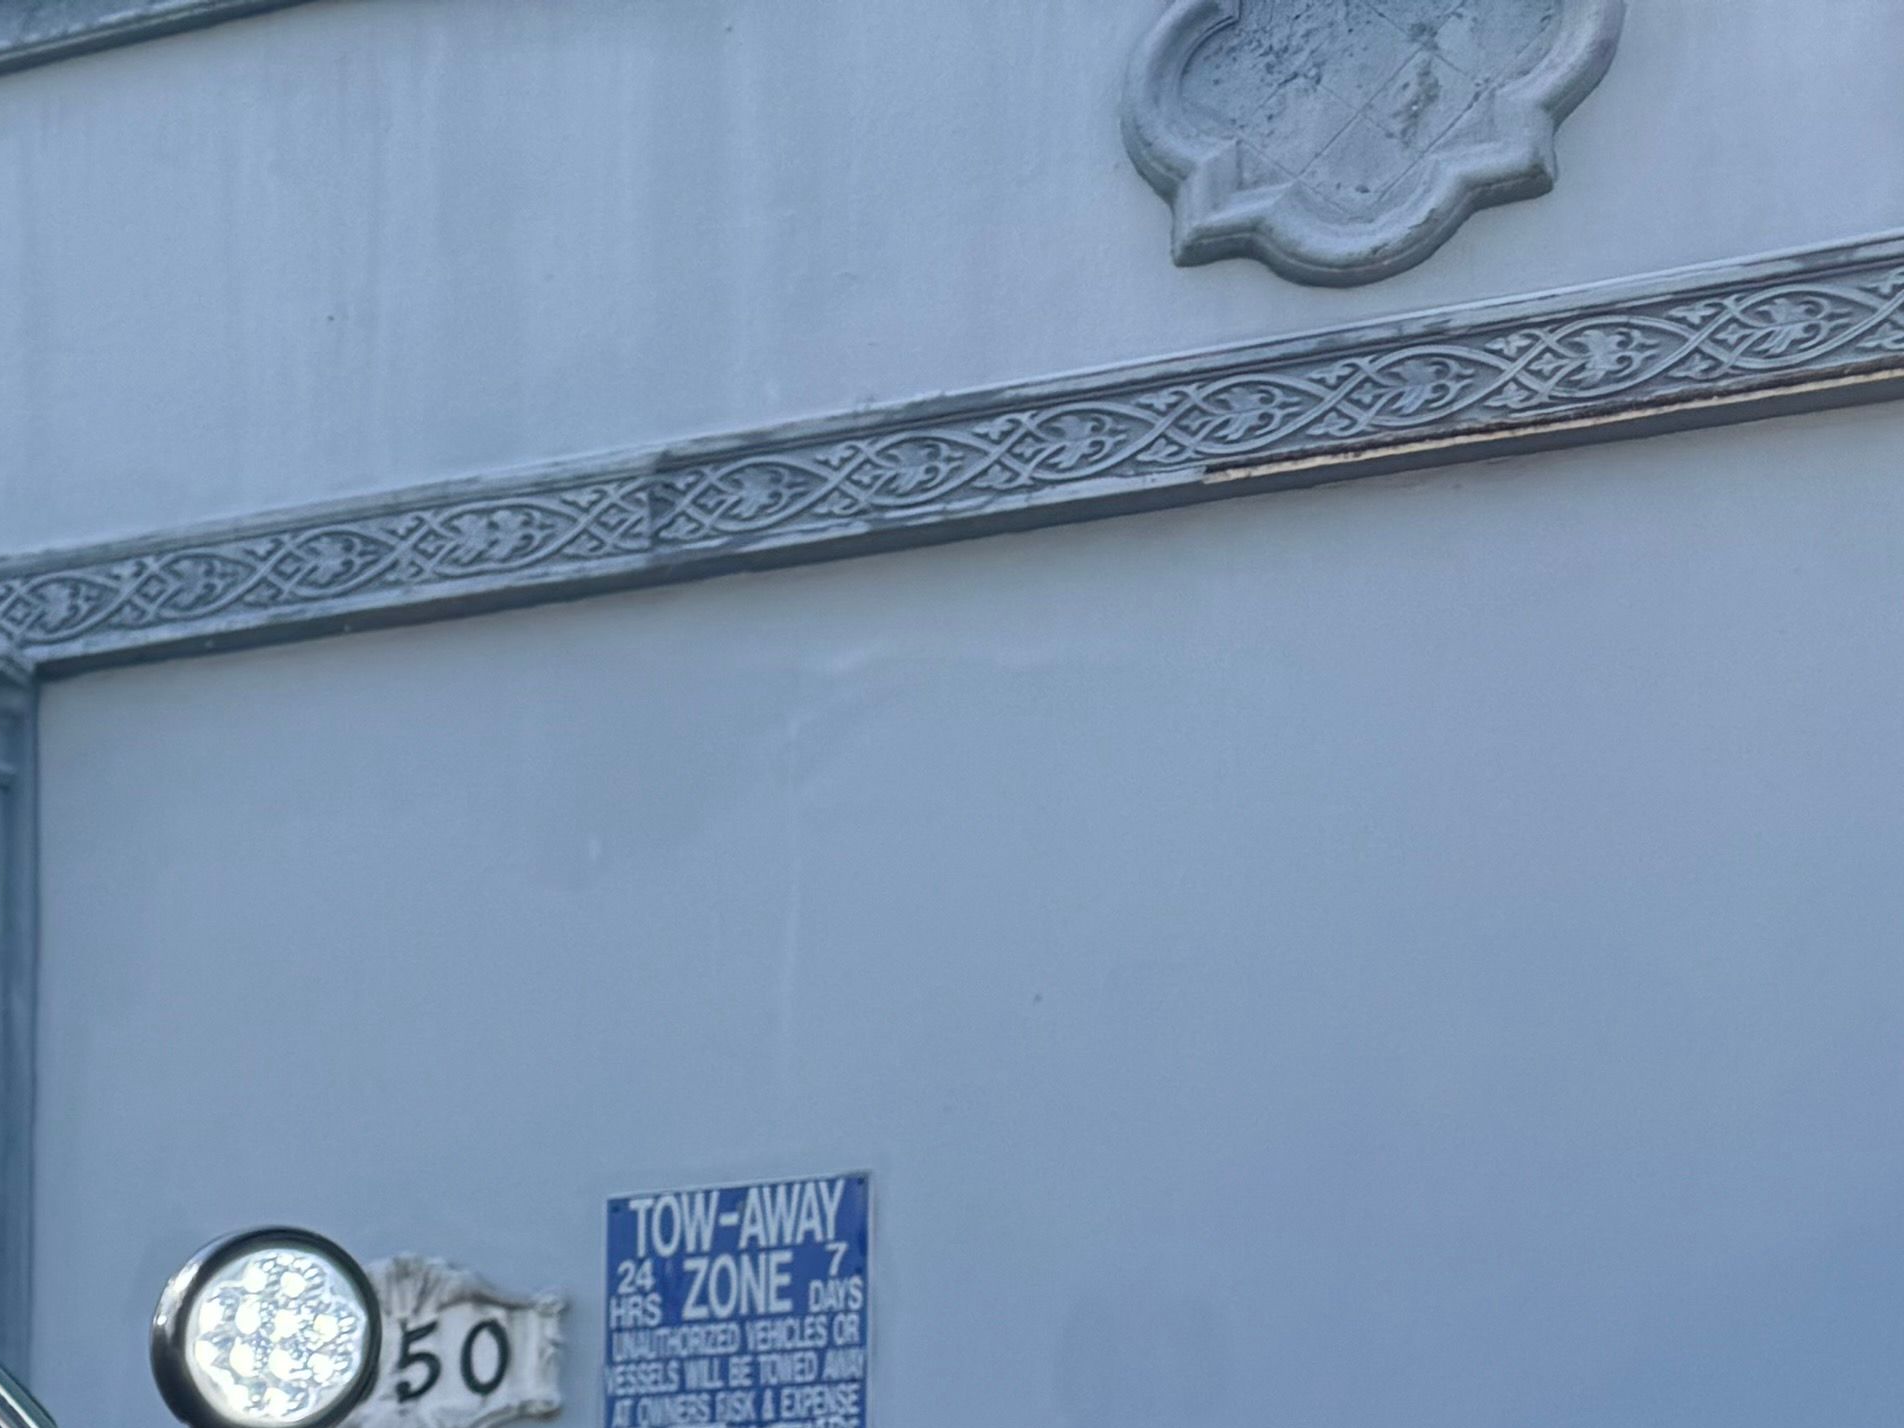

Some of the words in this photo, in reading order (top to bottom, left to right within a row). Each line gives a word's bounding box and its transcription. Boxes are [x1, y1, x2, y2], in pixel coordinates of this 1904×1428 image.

[629, 1179, 846, 1257] TOW-AWAY
[617, 1259, 654, 1294] 24
[826, 1242, 848, 1276] 7
[682, 1251, 793, 1320] ZONE
[808, 1275, 864, 1313] DAYS
[610, 1293, 662, 1328] HRS
[612, 1322, 739, 1362] UNAUTHORIZED
[746, 1313, 827, 1351] VEHICLES
[832, 1312, 860, 1346] OR
[607, 1360, 680, 1397] VESSELS
[683, 1356, 725, 1391] WILL
[728, 1354, 753, 1387] BE
[757, 1350, 819, 1386] TOWED
[612, 1397, 633, 1428] AT
[715, 1389, 757, 1420] RISK
[780, 1382, 861, 1418] EXPENSE
